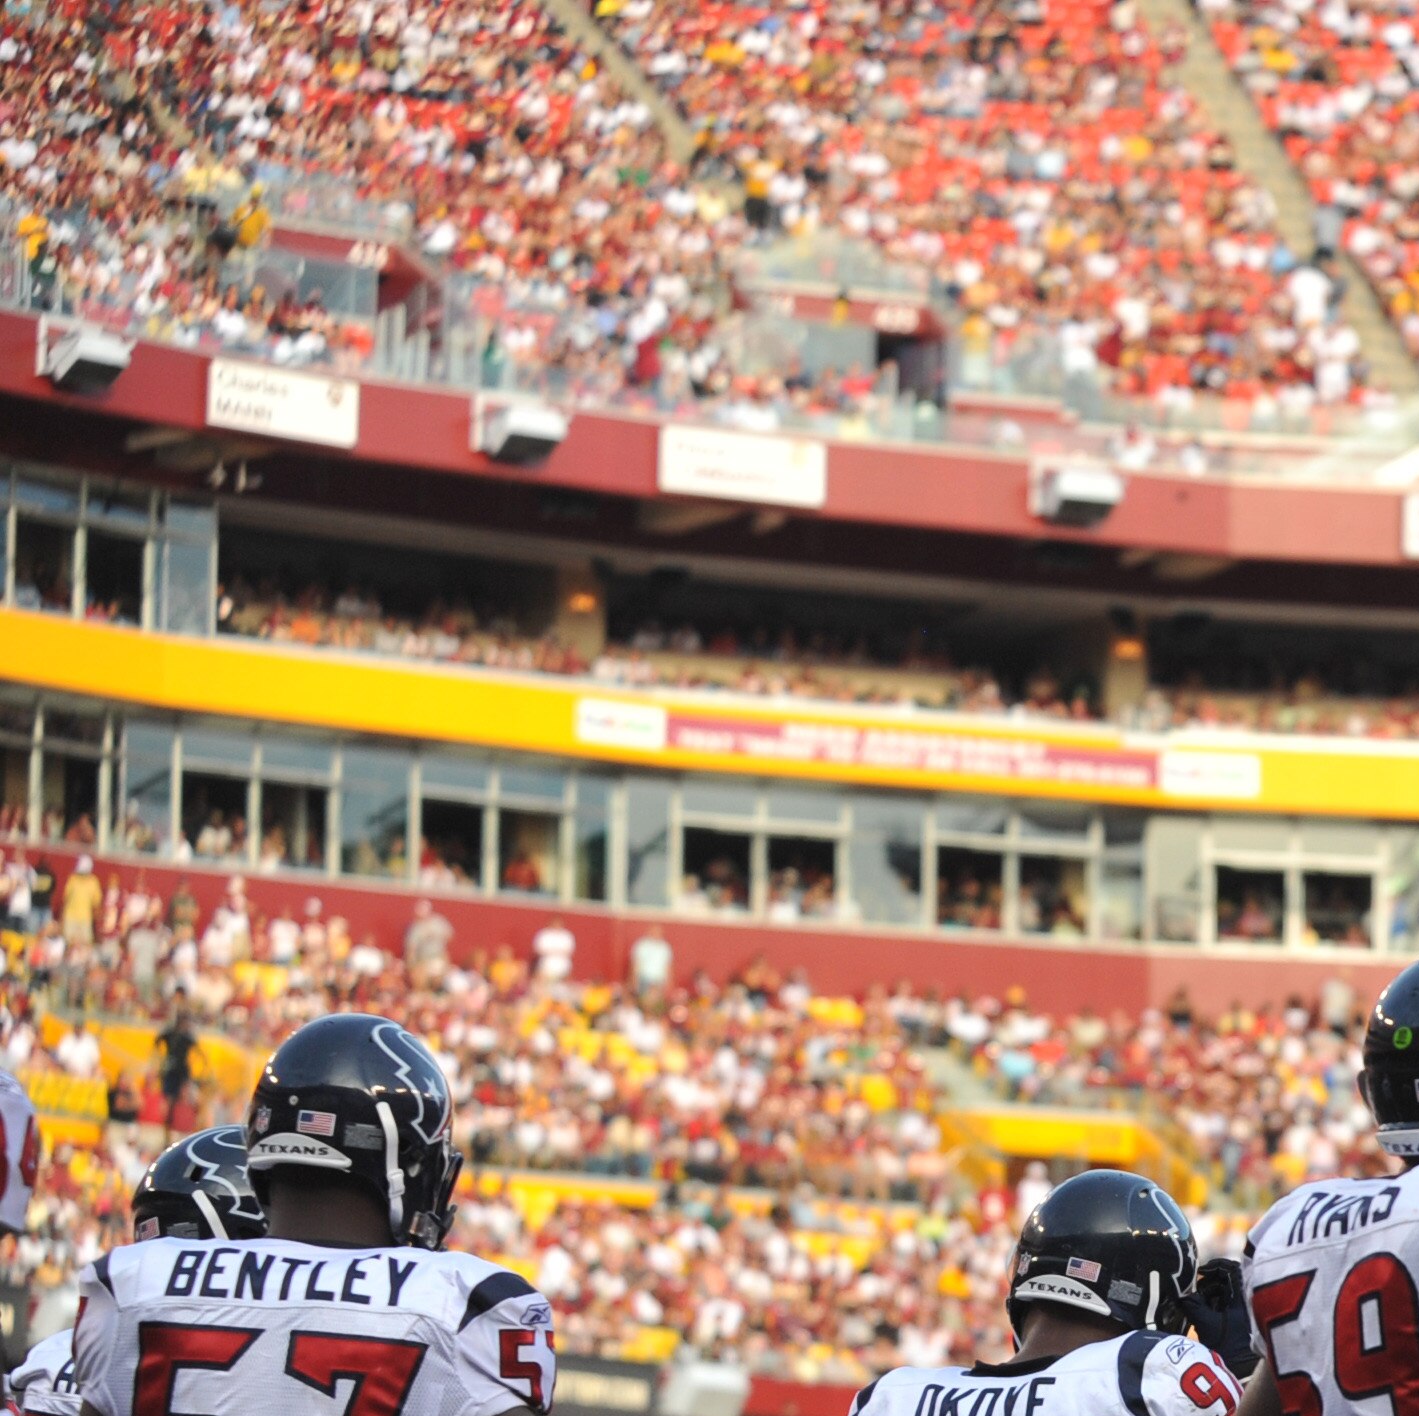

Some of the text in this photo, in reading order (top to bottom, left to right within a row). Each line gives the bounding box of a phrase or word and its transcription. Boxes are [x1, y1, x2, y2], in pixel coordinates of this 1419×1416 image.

[260, 1143, 330, 1156] TEXANS
[164, 1248, 420, 1308] BENTLEY
[1027, 1280, 1092, 1300] TEXANS
[499, 1328, 556, 1412] 5
